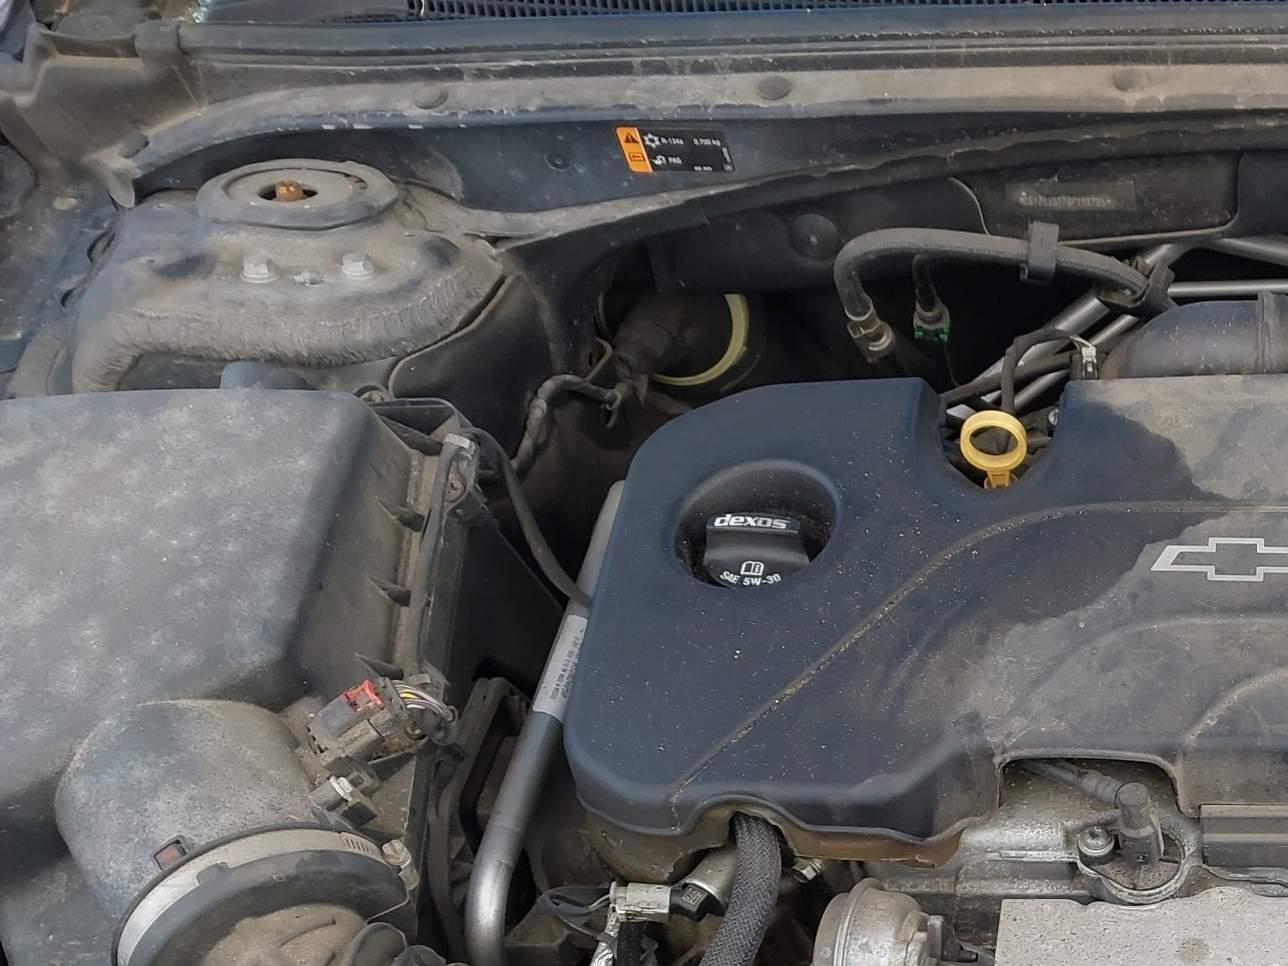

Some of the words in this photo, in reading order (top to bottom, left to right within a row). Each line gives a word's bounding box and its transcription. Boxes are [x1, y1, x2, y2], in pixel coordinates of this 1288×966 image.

[714, 514, 790, 529] dexos
[720, 570, 740, 584] SAE
[743, 573, 782, 586] 5W-30
